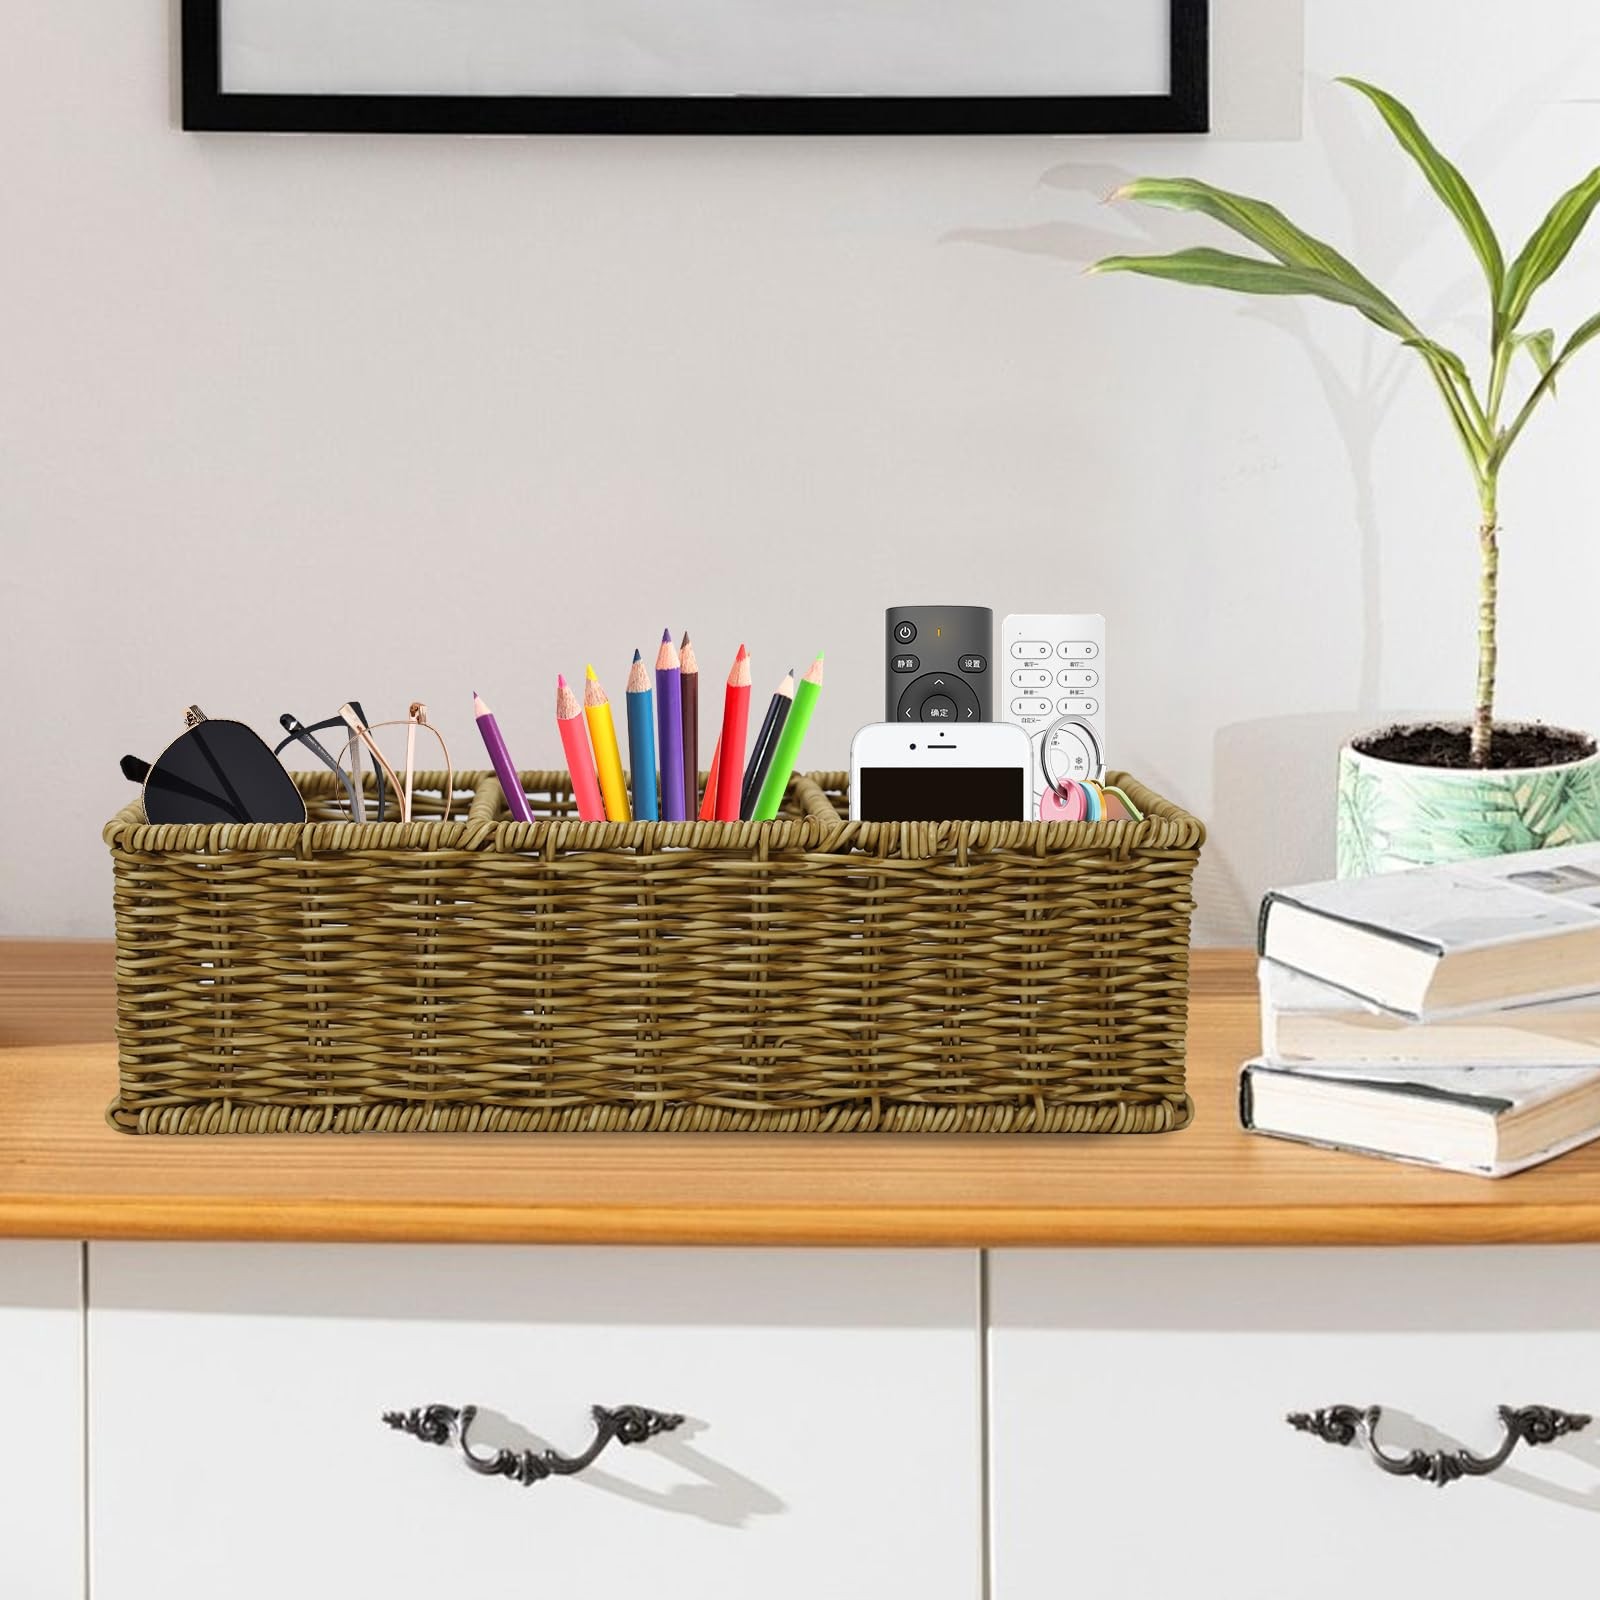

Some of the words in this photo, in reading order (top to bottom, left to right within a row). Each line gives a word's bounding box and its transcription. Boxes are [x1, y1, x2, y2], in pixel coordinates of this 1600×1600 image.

[897, 659, 914, 668] 静音
[965, 659, 981, 668] 设置
[930, 708, 949, 718] 确定
